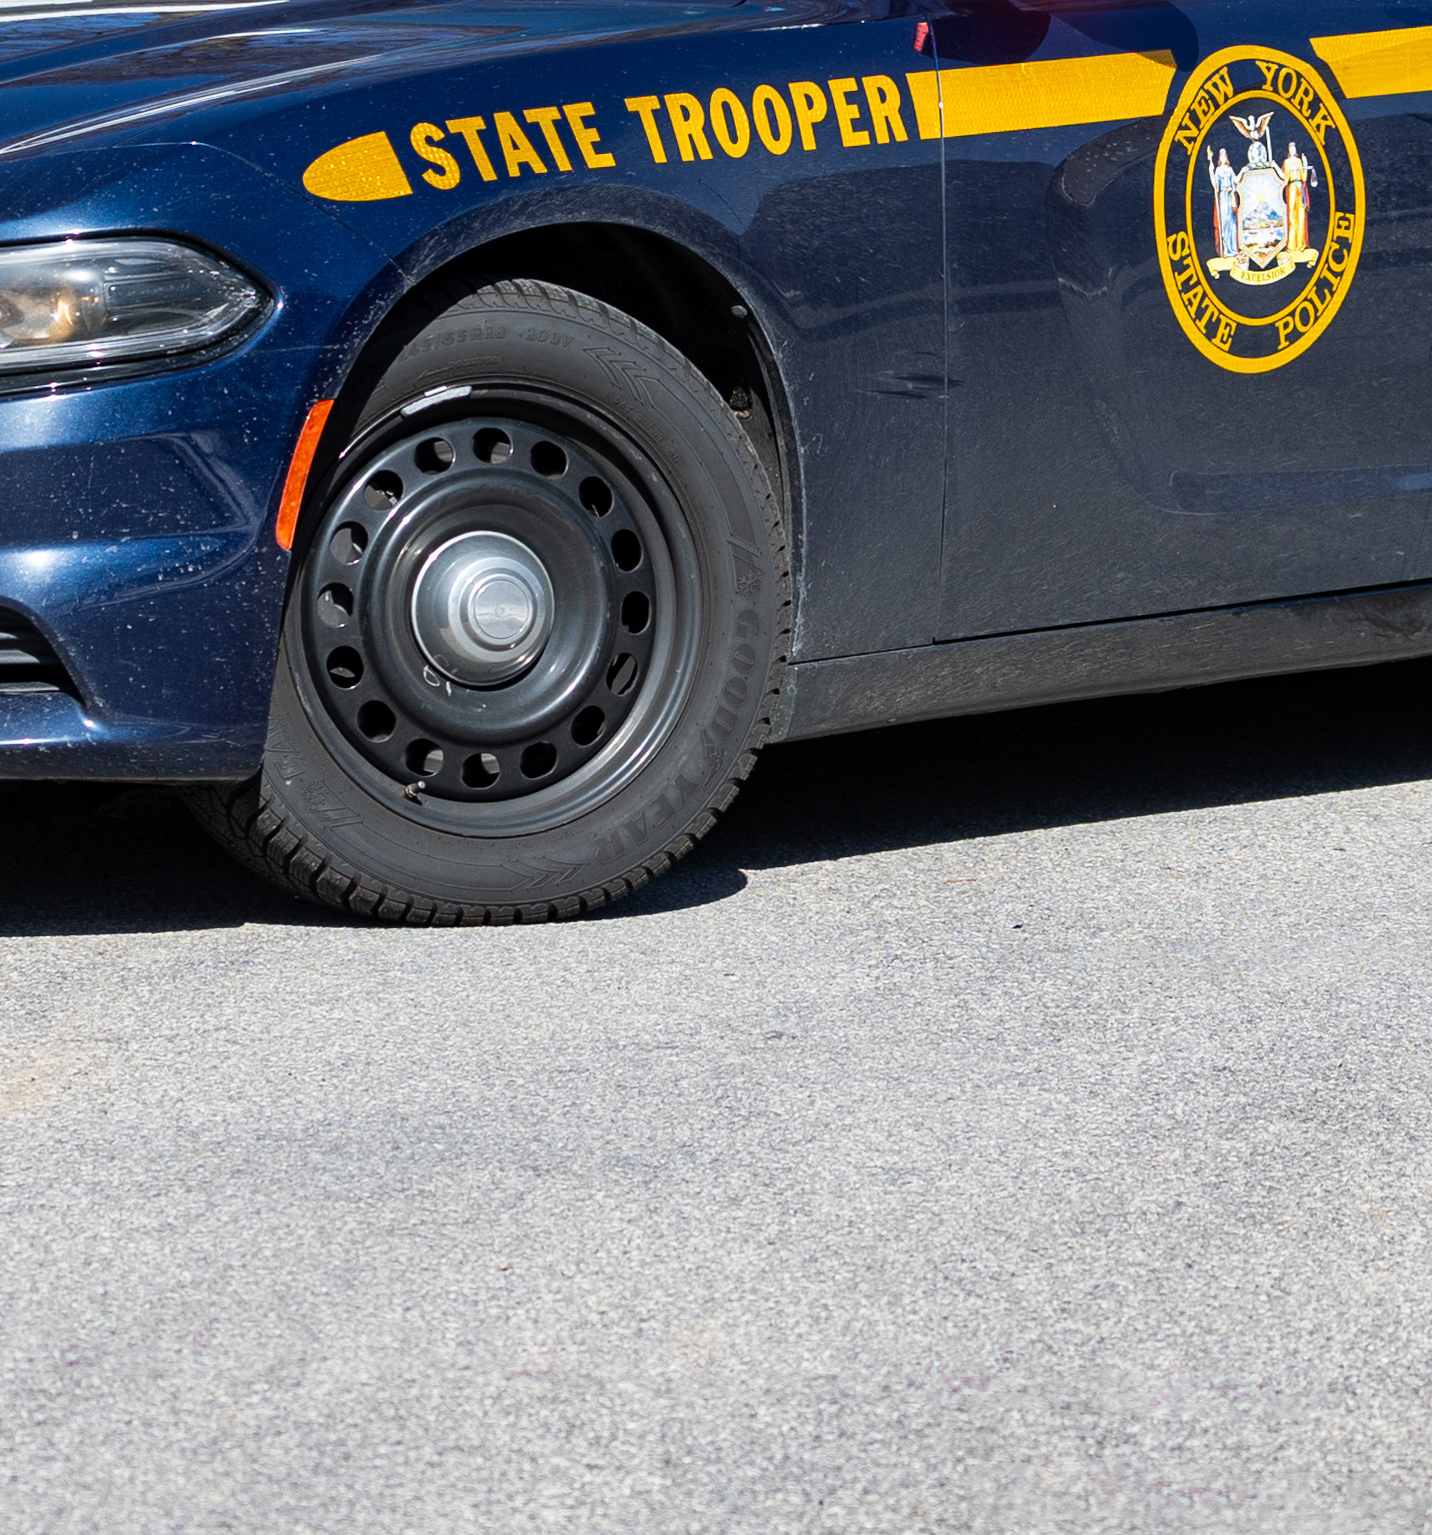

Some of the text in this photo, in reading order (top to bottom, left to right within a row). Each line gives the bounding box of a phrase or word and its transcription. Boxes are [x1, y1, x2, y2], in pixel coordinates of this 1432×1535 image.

[411, 74, 909, 190] STATE TROOPER
[1174, 60, 1336, 155] NEW YORK
[1167, 212, 1355, 352] STATE POLICE
[1240, 266, 1286, 283] EXCELSIOR
